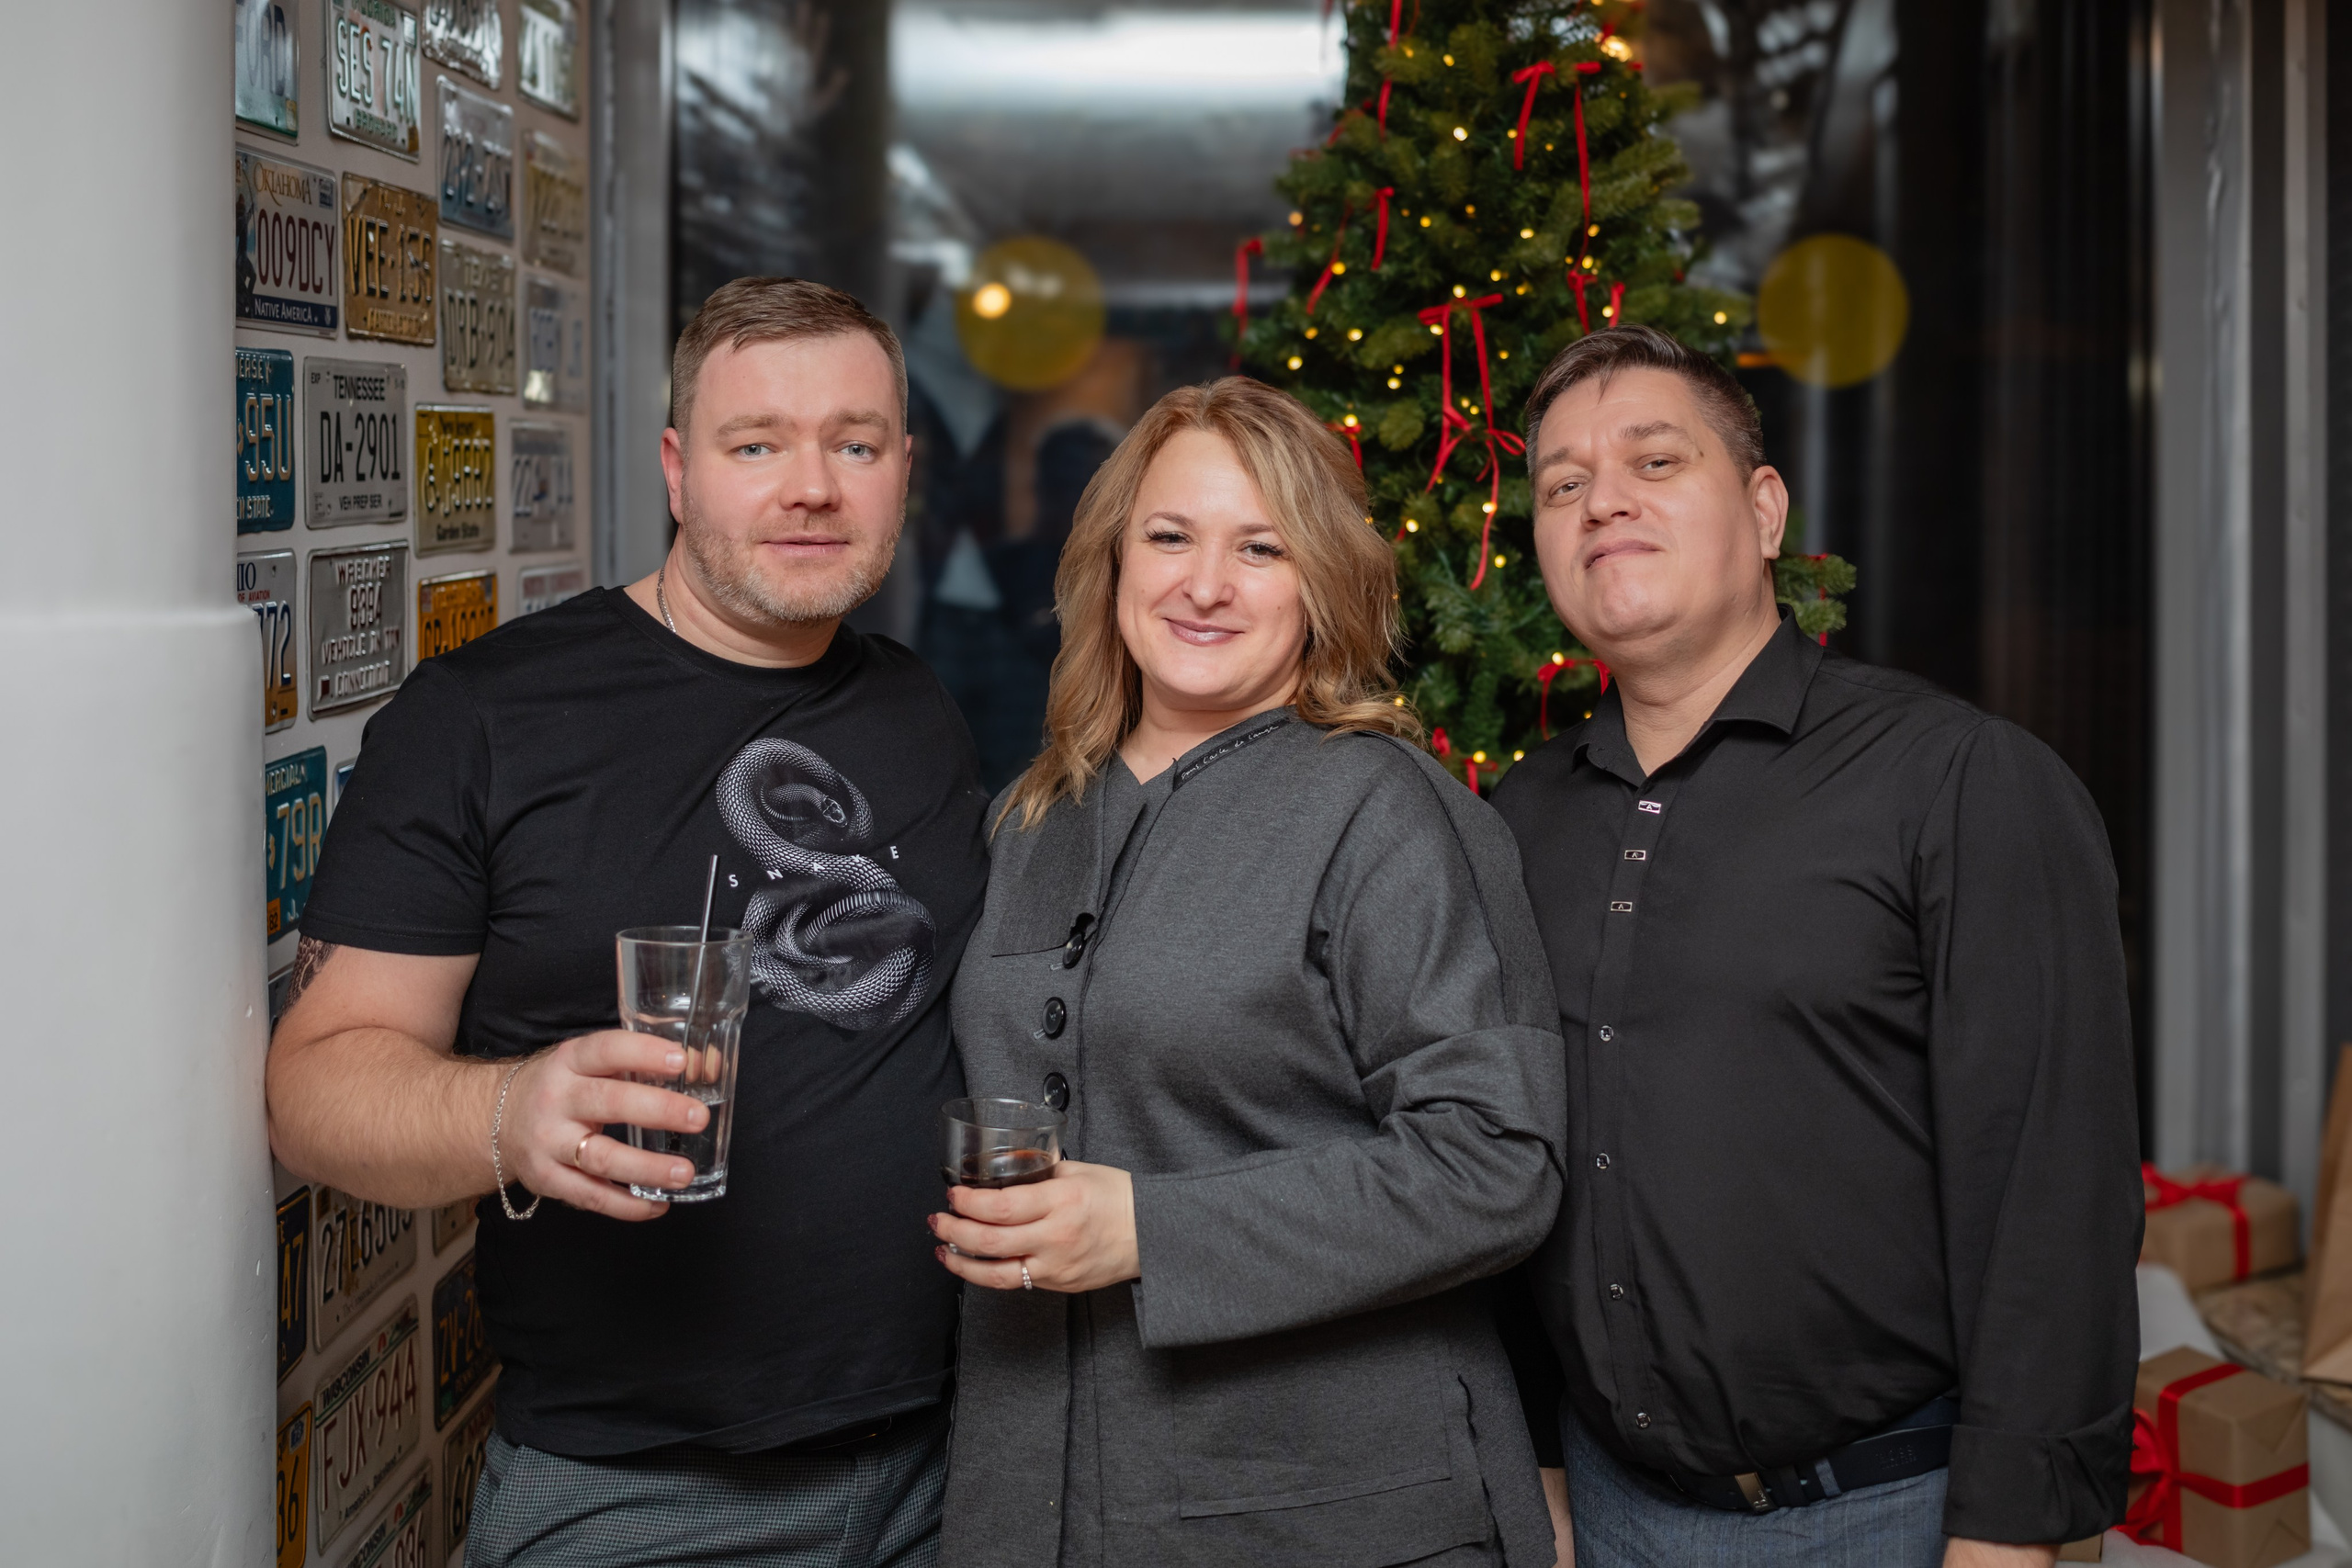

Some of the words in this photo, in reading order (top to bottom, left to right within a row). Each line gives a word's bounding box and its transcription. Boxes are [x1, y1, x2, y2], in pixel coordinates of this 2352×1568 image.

[335, 16, 375, 108] SES
[379, 34, 420, 131] 74N
[253, 162, 312, 208] OKLAHOMA
[257, 208, 335, 297] 009DCY
[254, 298, 280, 319] NATIVE
[280, 302, 312, 323] AMERICA
[311, 371, 322, 384] EXP
[333, 375, 386, 400] TENNESSEE
[320, 411, 401, 484] DA-2901
[246, 495, 271, 519] STATE
[334, 555, 391, 585] WRECKER
[248, 590, 271, 603] AVIATION
[322, 631, 367, 665] VEHICLE
[277, 792, 322, 890] 79R
[323, 1347, 370, 1408] WISCONSIN
